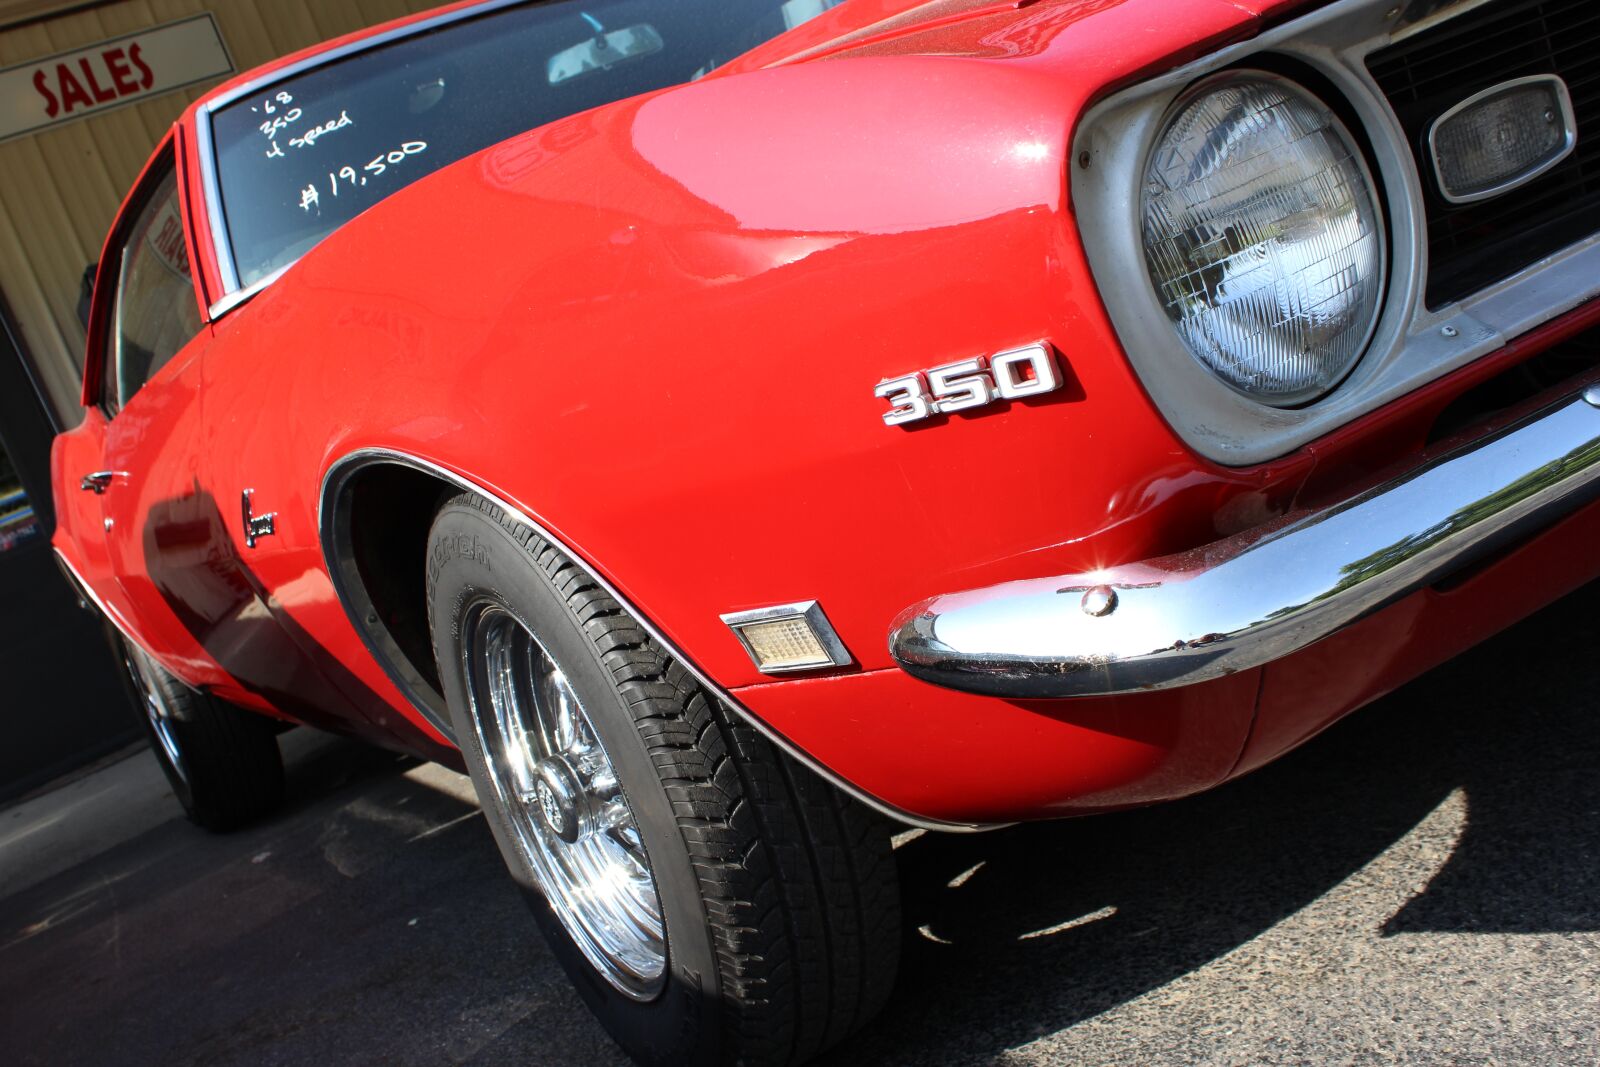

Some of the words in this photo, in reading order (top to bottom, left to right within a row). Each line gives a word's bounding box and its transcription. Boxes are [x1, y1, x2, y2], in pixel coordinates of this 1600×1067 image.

[32, 42, 154, 118] SALES
[260, 108, 302, 140] 350
[266, 141, 285, 158] 4
[289, 110, 353, 148] speed
[874, 339, 1062, 426] 350
